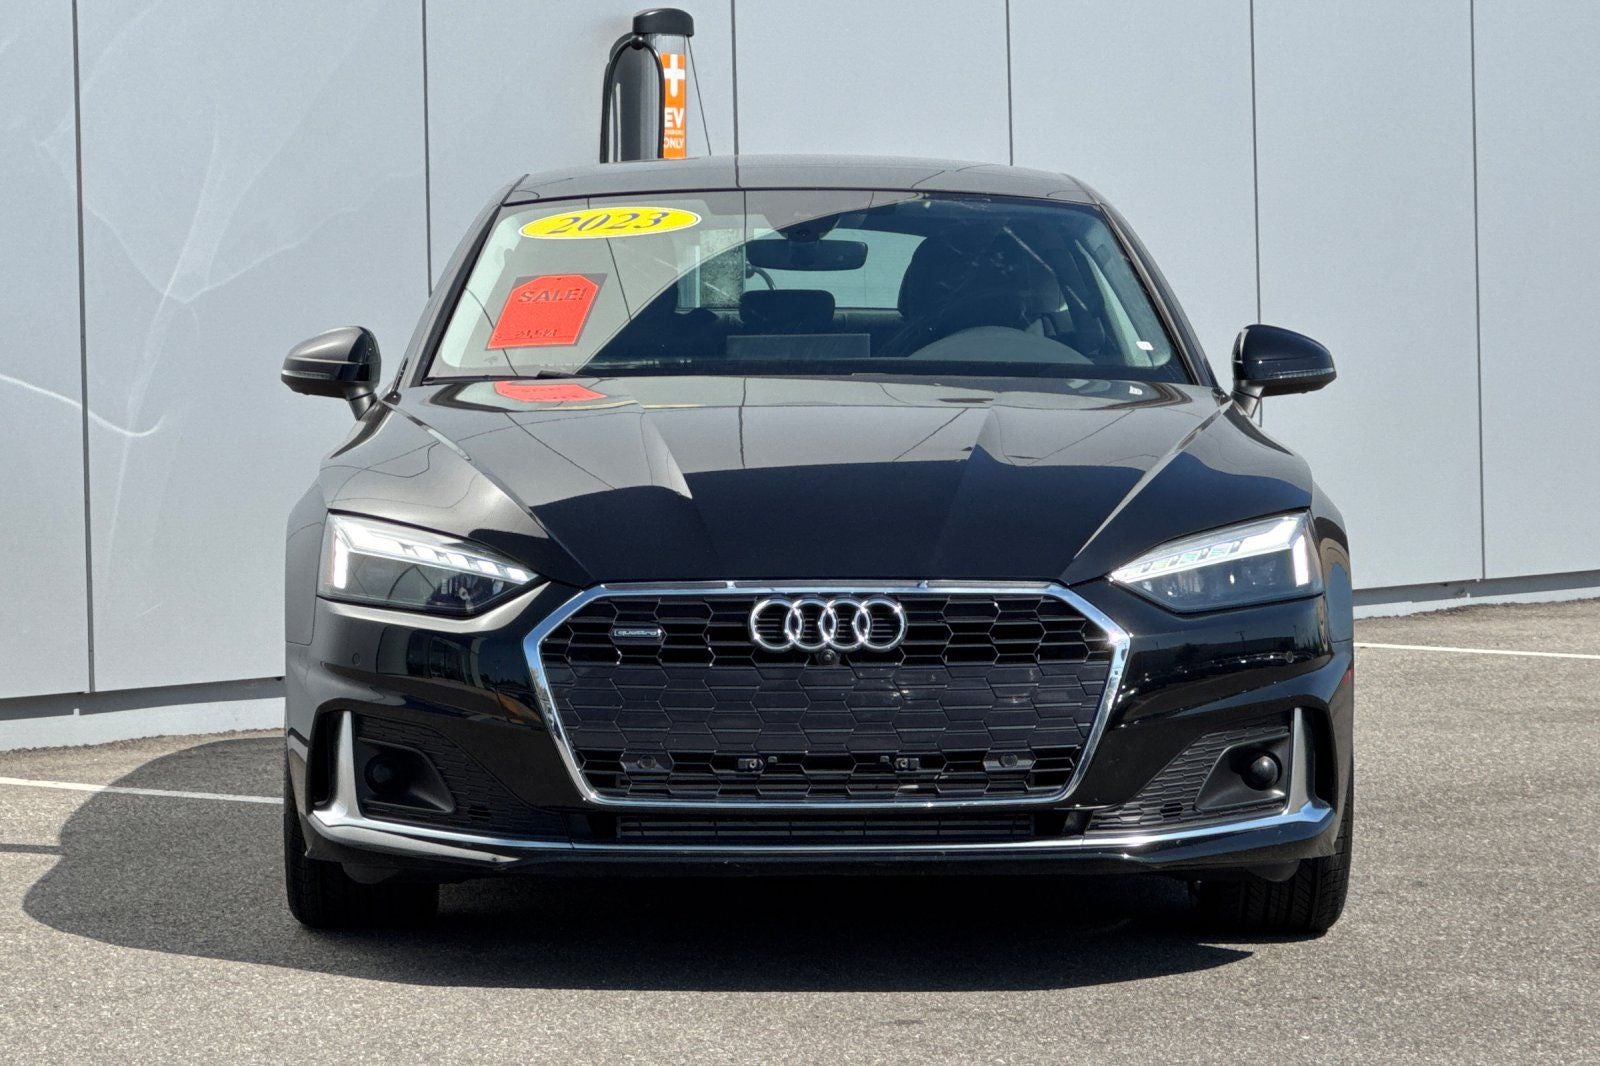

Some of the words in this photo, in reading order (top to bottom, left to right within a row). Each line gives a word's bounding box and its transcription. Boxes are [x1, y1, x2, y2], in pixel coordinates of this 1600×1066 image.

[664, 107, 684, 128] EV
[663, 137, 684, 149] ONLY
[547, 212, 669, 234] 2023
[518, 287, 587, 304] SALE!
